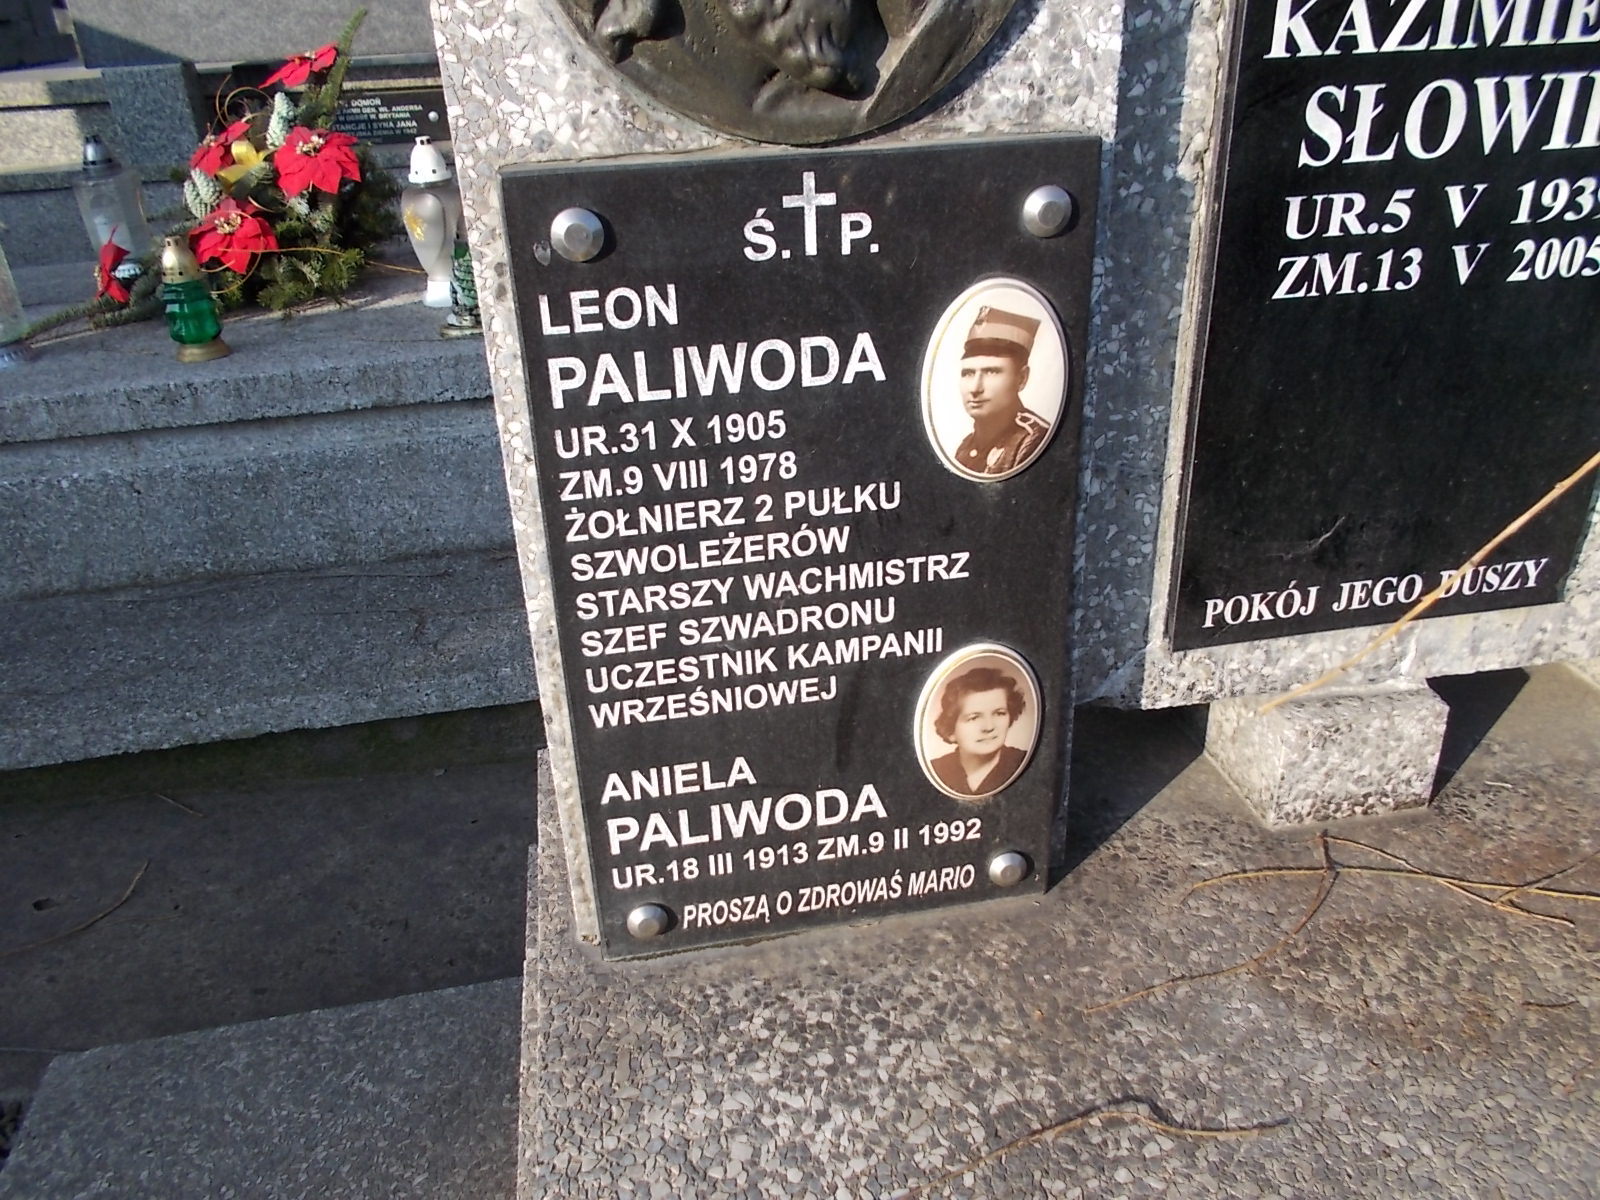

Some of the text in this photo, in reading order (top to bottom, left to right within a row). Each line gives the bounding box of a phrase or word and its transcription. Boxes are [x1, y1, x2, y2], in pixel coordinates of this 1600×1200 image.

[392, 104, 423, 112] ANDERSA
[396, 120, 418, 128] JANA
[743, 207, 880, 262] Ś. P.
[1285, 176, 1600, 241] UR.5 V 193
[1271, 234, 1600, 300] ZM.13 V 2005
[538, 283, 679, 336] LEON
[547, 332, 887, 410] PALIWODA
[554, 410, 787, 460] UR.31 X 1905
[558, 451, 798, 502] ZM.9 VIII 1978
[564, 481, 901, 543] ŻOŁNIERZ 2 PUŁKU
[570, 525, 850, 582] SZWOLEŻERÓW
[576, 552, 971, 620] STARSZY WACHMISTRZ
[1201, 557, 1549, 629] POKÓJ JEGO DUSZY
[580, 597, 896, 657] SZEF SZWADRONU
[585, 628, 943, 694] UCZESTNIK KAMPANII
[589, 675, 838, 729] WRZEŚNIOWEJ
[600, 756, 757, 805] ANIELA
[606, 784, 888, 856] PALIWODA
[612, 817, 983, 890] UR.18 III 1913 ZM.9 II 1992
[682, 863, 976, 929] PROSZĄ O ZDROWAŚ MARIO
